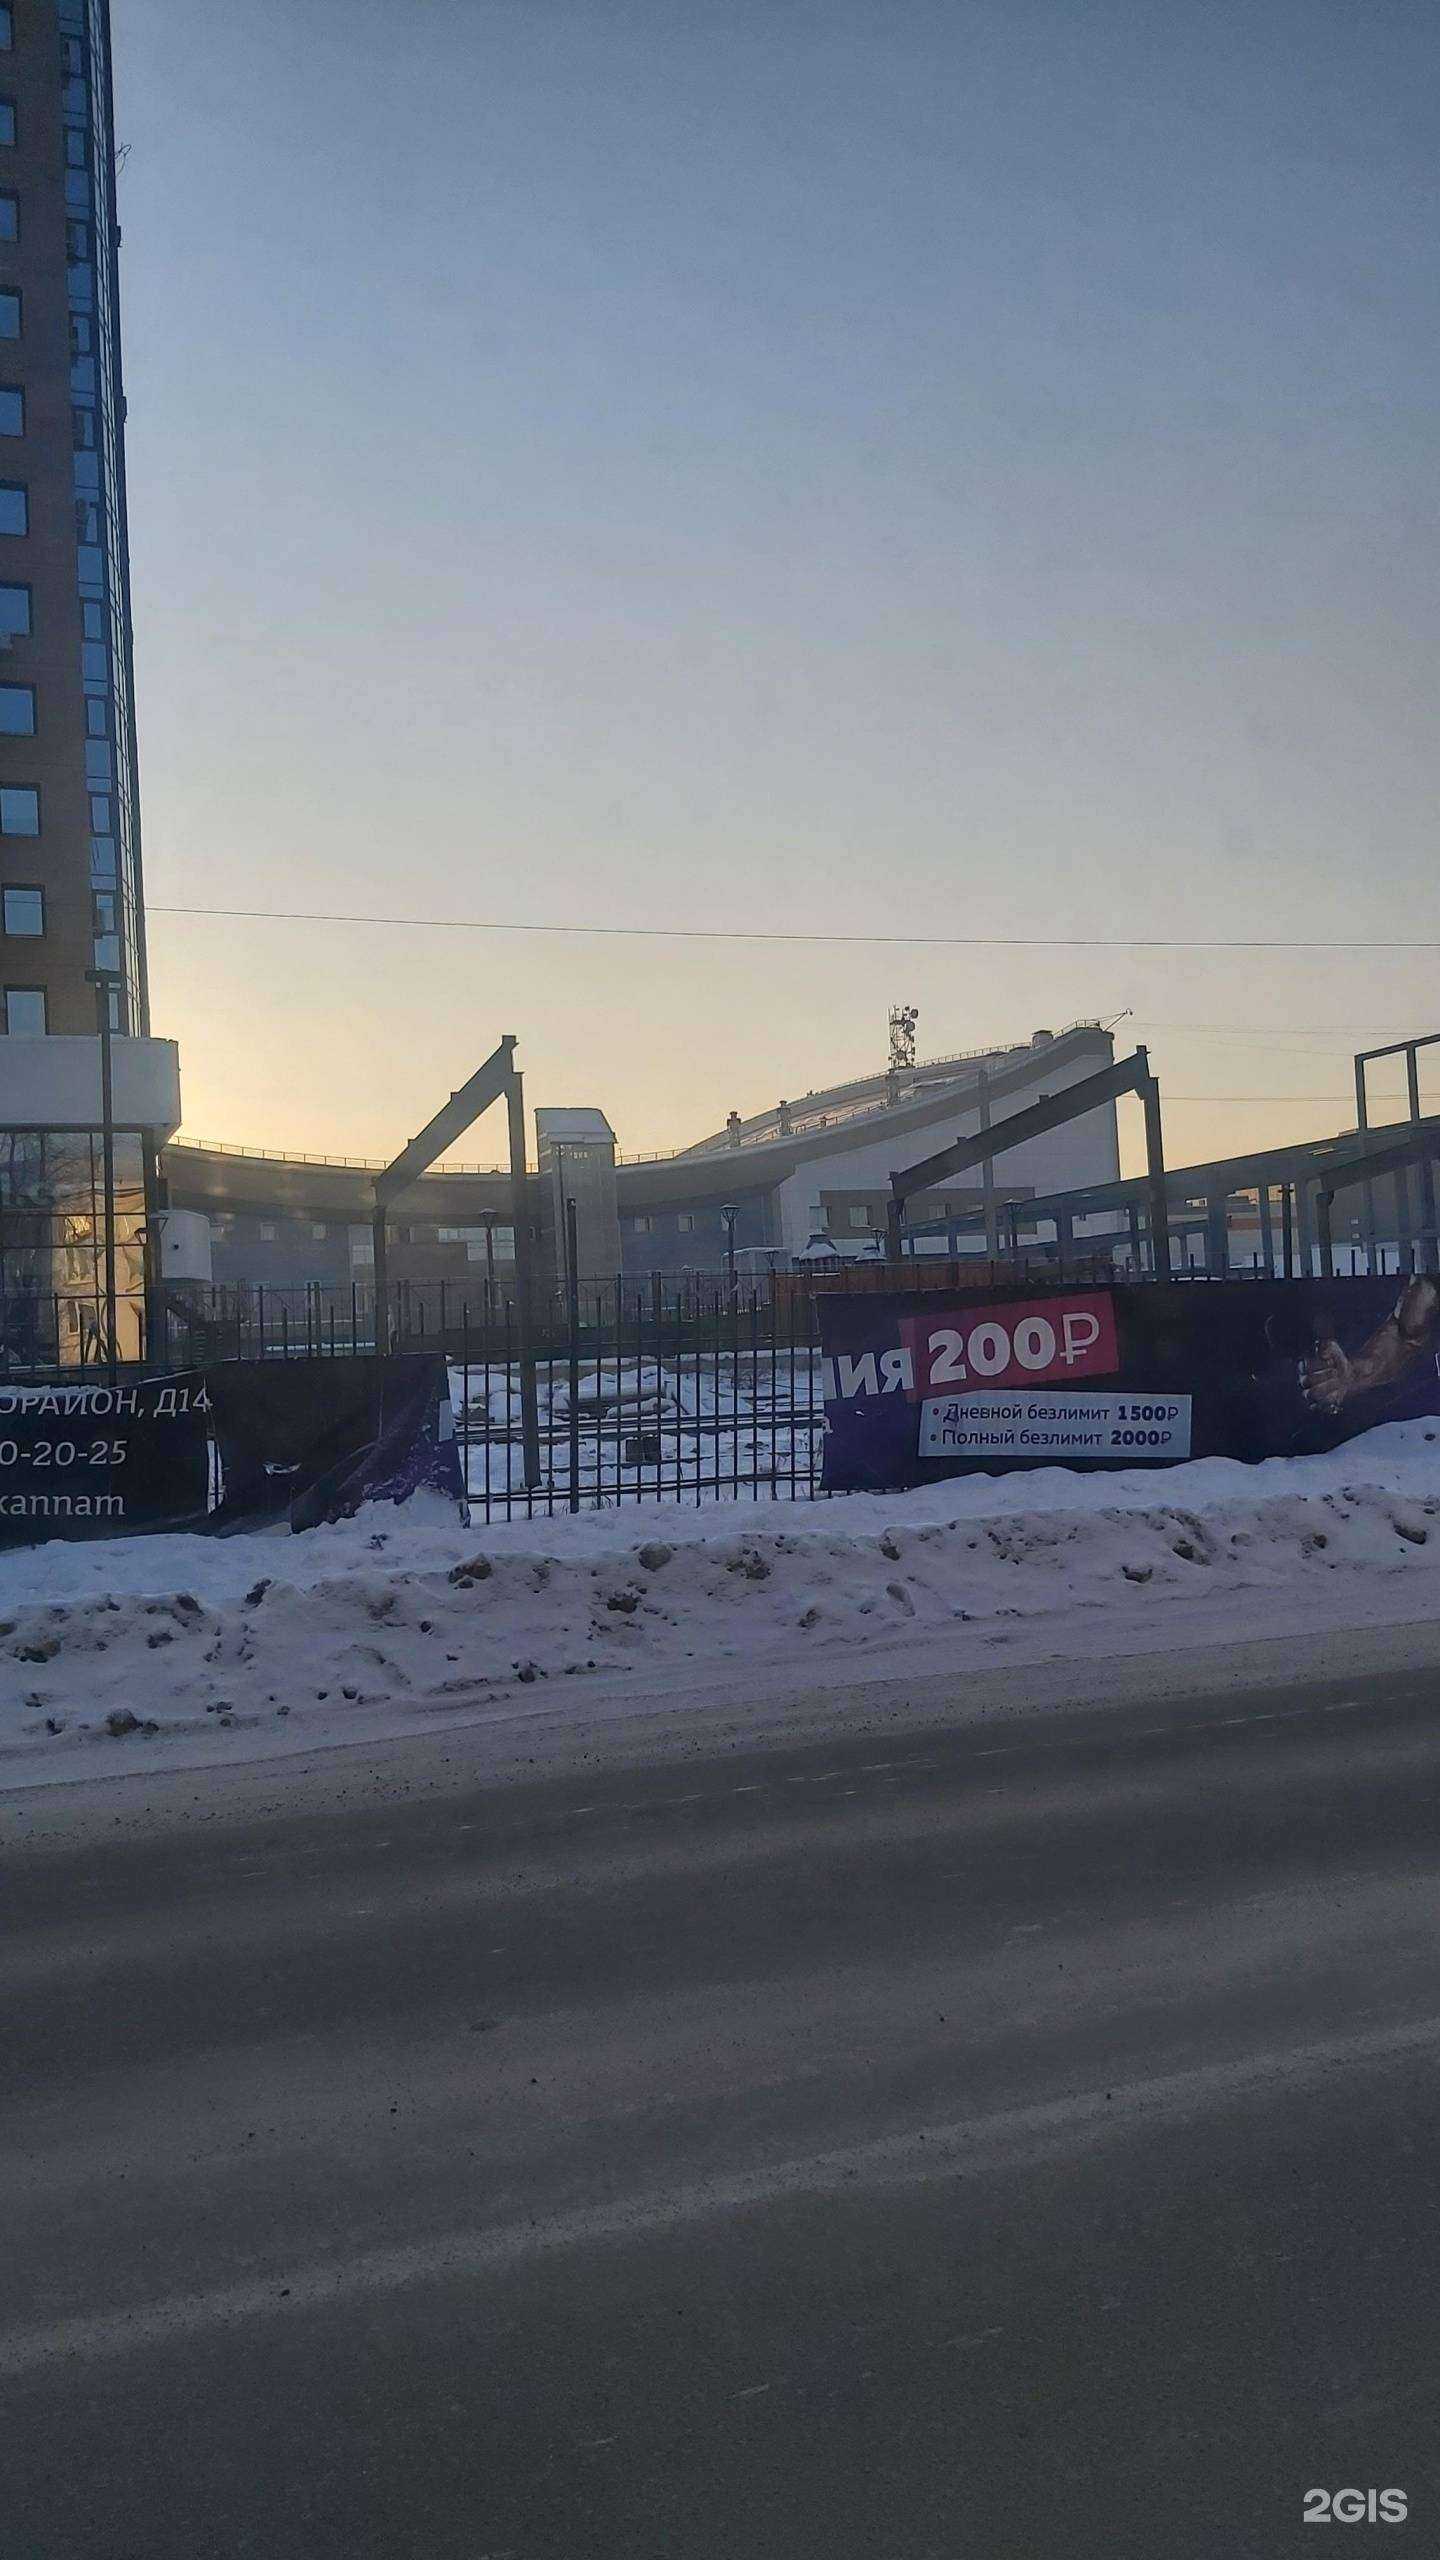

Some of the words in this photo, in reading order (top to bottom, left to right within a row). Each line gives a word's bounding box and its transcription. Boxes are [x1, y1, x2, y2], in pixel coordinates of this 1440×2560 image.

[153, 1388, 214, 1418] Д14
[943, 1403, 1022, 1423] Дневной
[1027, 1404, 1110, 1421] безлимит
[942, 1429, 1015, 1445] Полный
[1020, 1429, 1103, 1446] безлимит
[0, 1440, 128, 1466] 0-20-25
